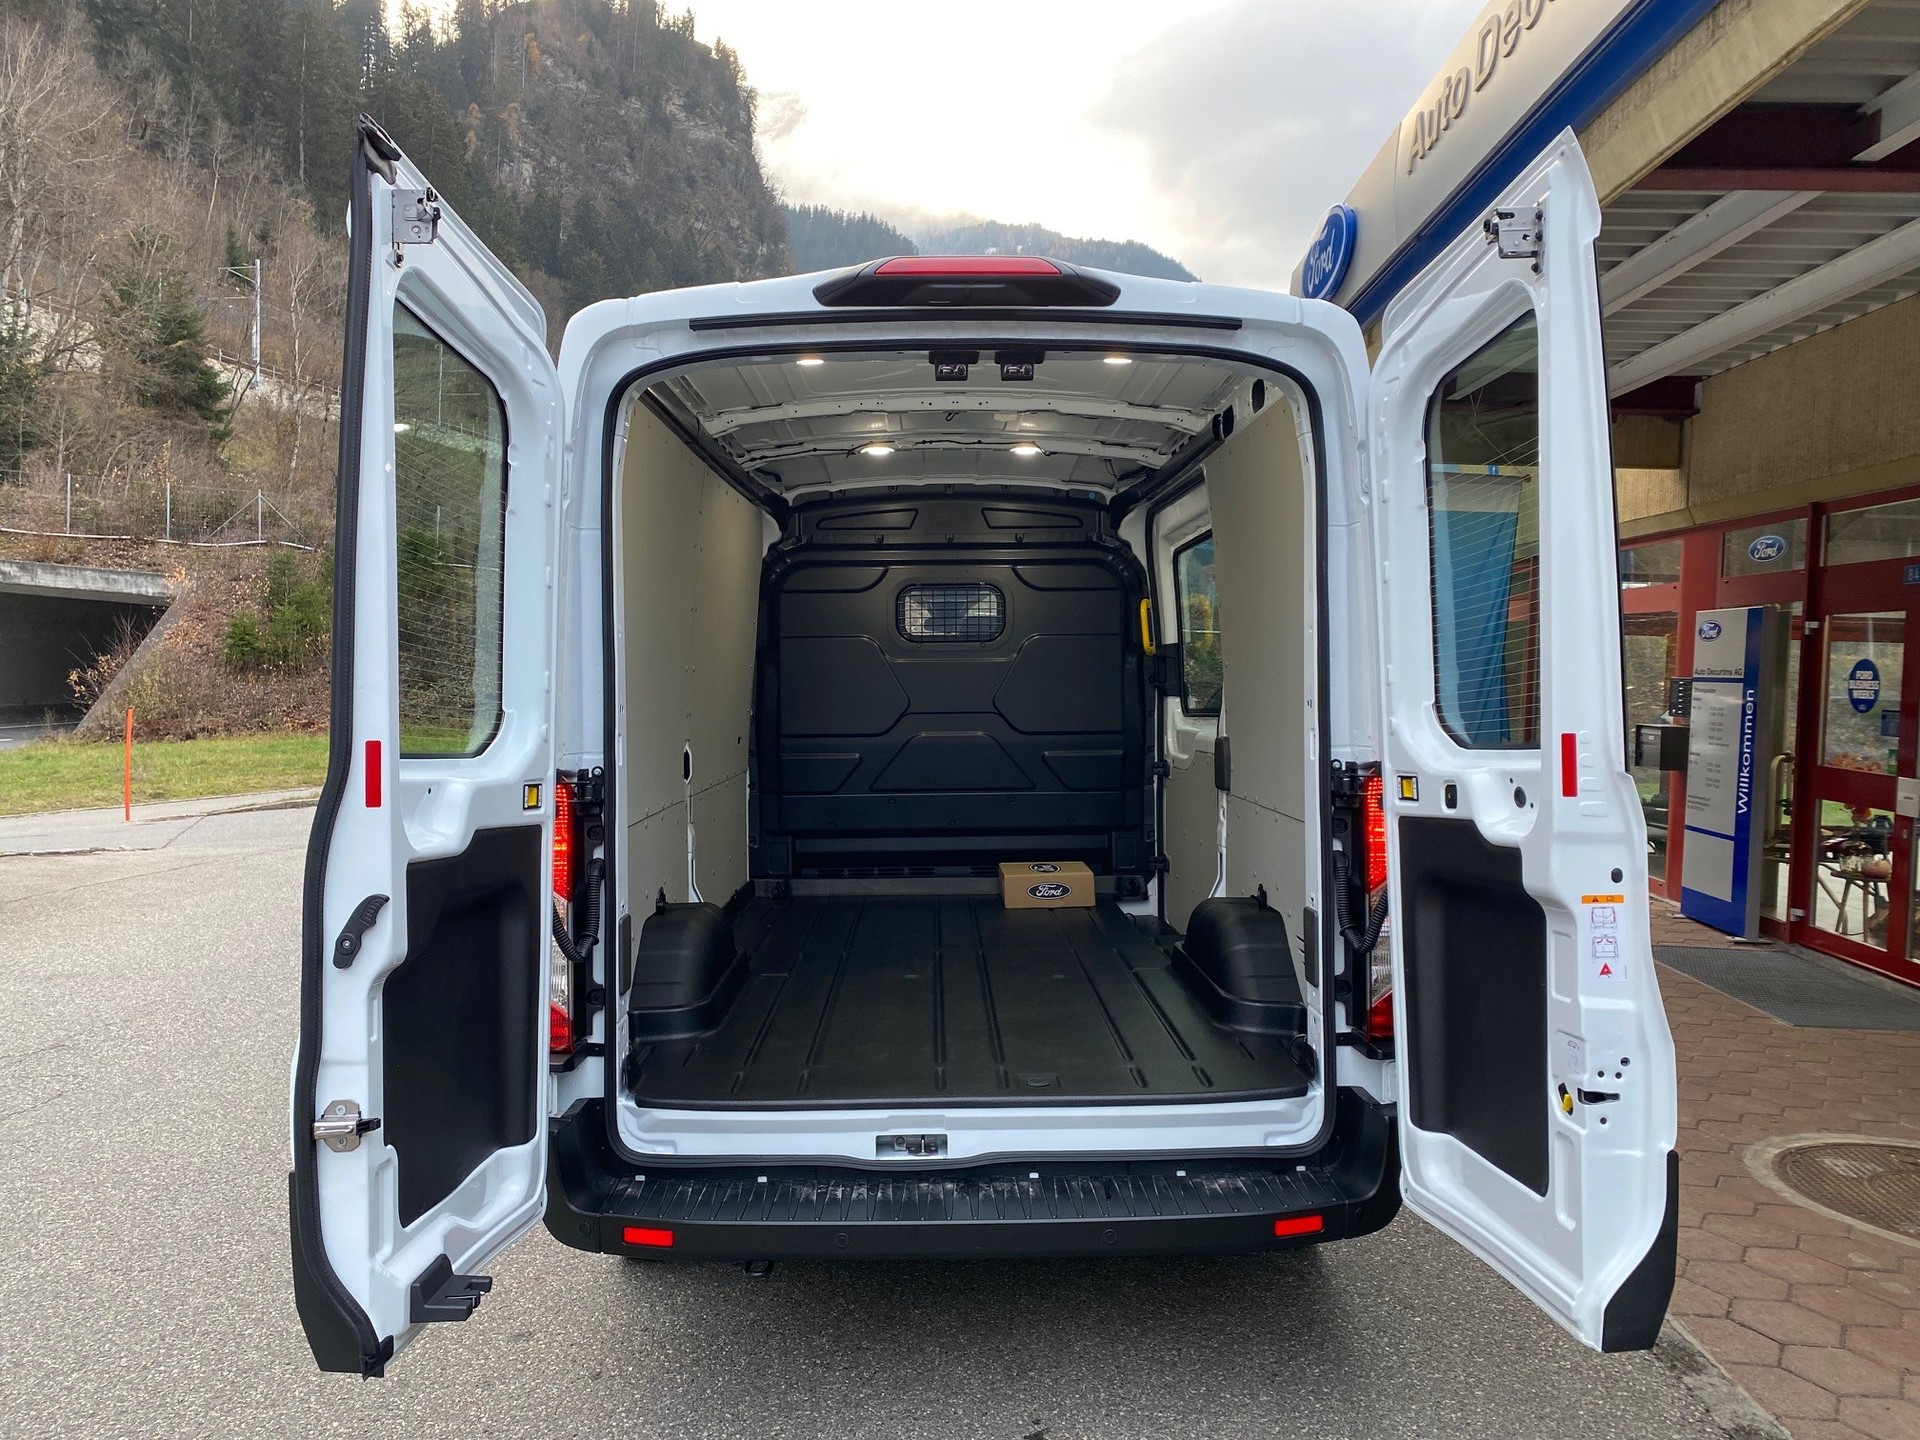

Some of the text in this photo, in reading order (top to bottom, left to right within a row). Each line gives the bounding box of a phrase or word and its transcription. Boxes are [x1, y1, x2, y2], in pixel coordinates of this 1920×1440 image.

[1408, 66, 1470, 175] Auto
[1734, 667, 1743, 676] AG
[1856, 670, 1873, 680] FORD
[1849, 680, 1880, 690] BUSINESS
[1853, 690, 1875, 700] WEEKS
[1737, 690, 1755, 814] Willkommen
[1036, 884, 1063, 896] Ford
